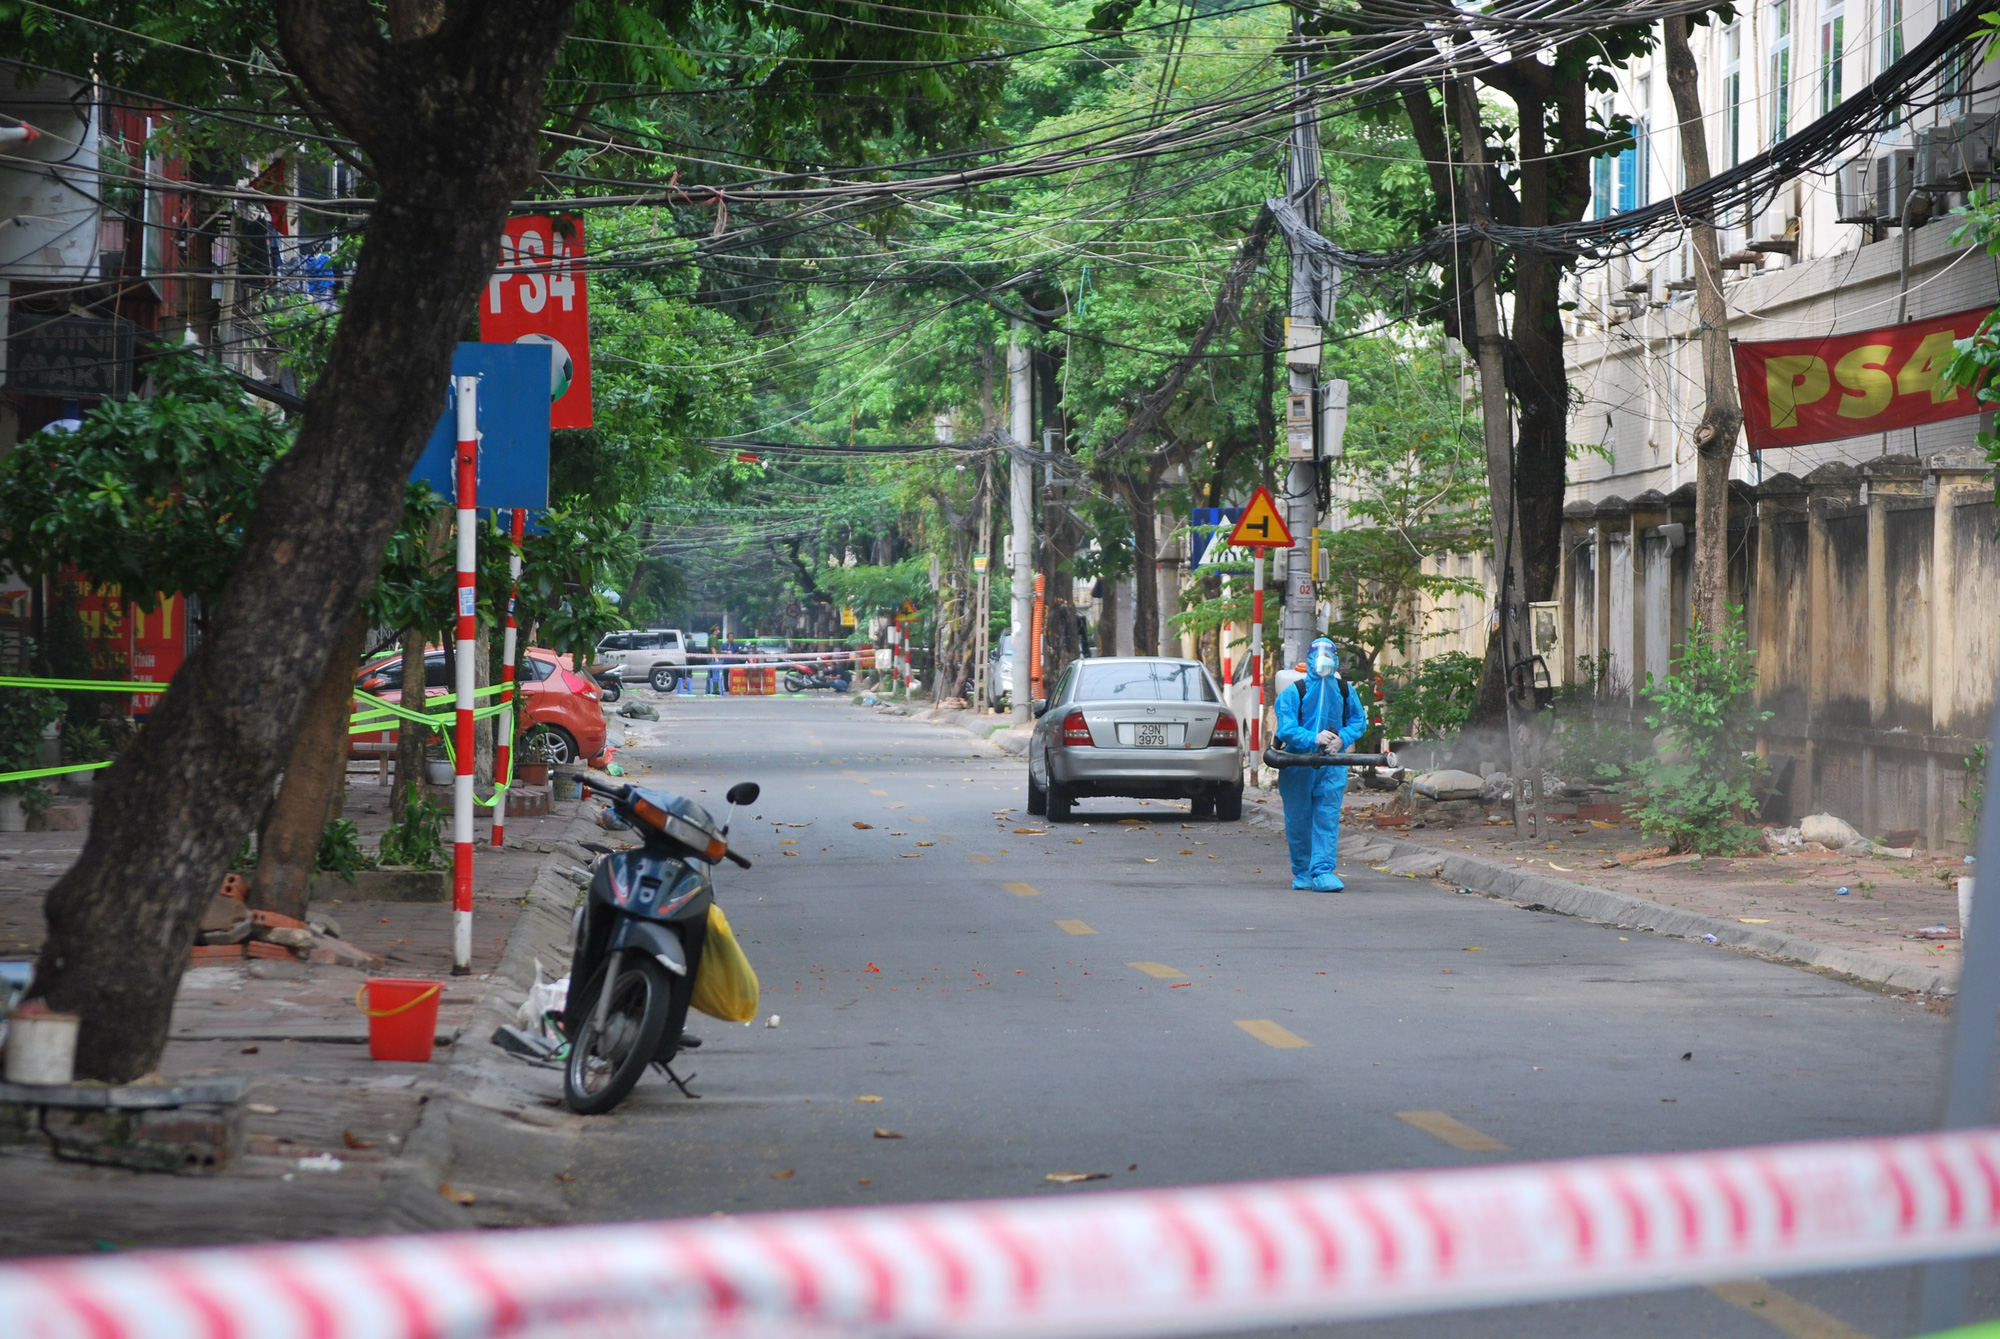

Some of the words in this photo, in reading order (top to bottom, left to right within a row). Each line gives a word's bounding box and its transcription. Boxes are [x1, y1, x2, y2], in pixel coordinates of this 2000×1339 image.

[489, 230, 575, 314] PS4
[31, 326, 115, 353] MINI
[1765, 329, 1958, 429] PS4
[1300, 585, 1311, 595] 02
[1142, 725, 1161, 736] 29N
[1138, 736, 1164, 745] 3979
